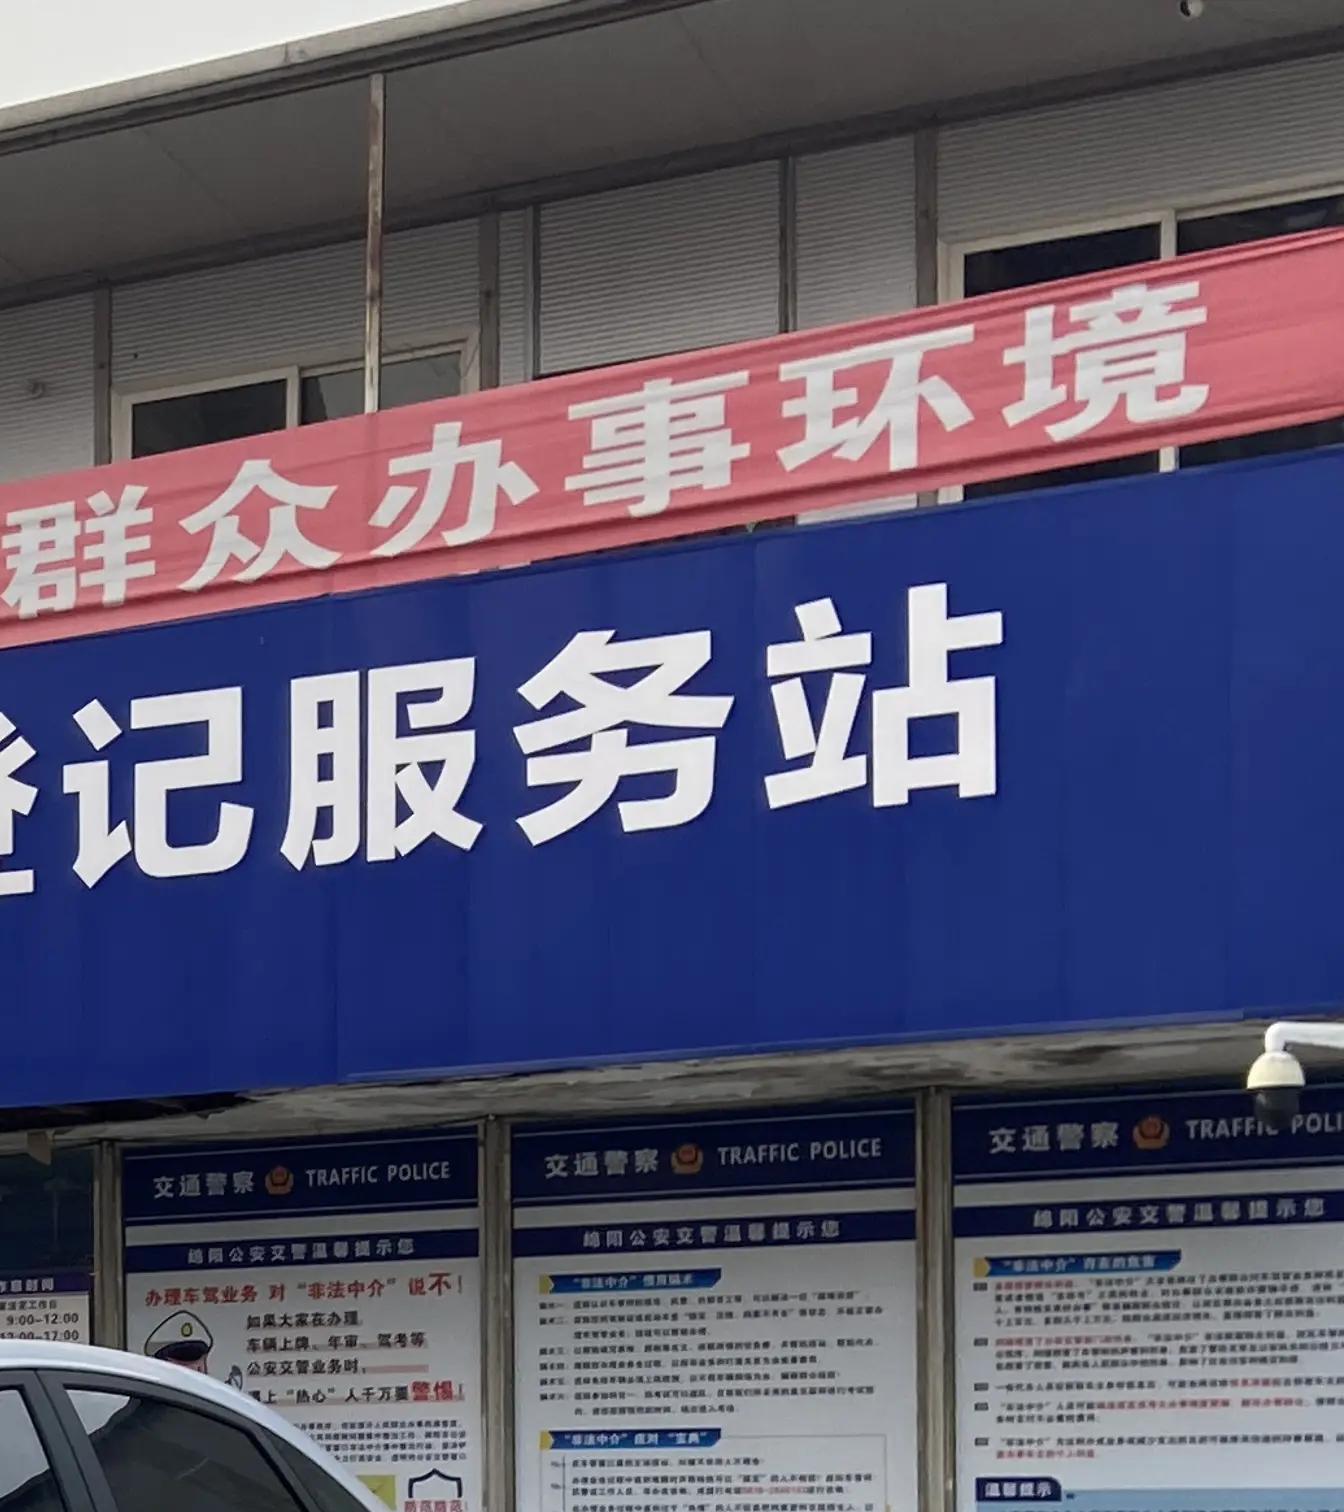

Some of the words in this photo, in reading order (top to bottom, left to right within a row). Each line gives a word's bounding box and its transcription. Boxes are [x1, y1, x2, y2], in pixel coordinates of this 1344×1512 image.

[989, 1121, 1119, 1154] 交通警察
[544, 1148, 660, 1179] 交通警察
[717, 1143, 799, 1166] TRAFFIC
[810, 1138, 882, 1160] POLICE
[153, 1170, 254, 1199] 交通警察
[305, 1165, 378, 1187] TRAFFIC
[387, 1161, 451, 1182] POLICE
